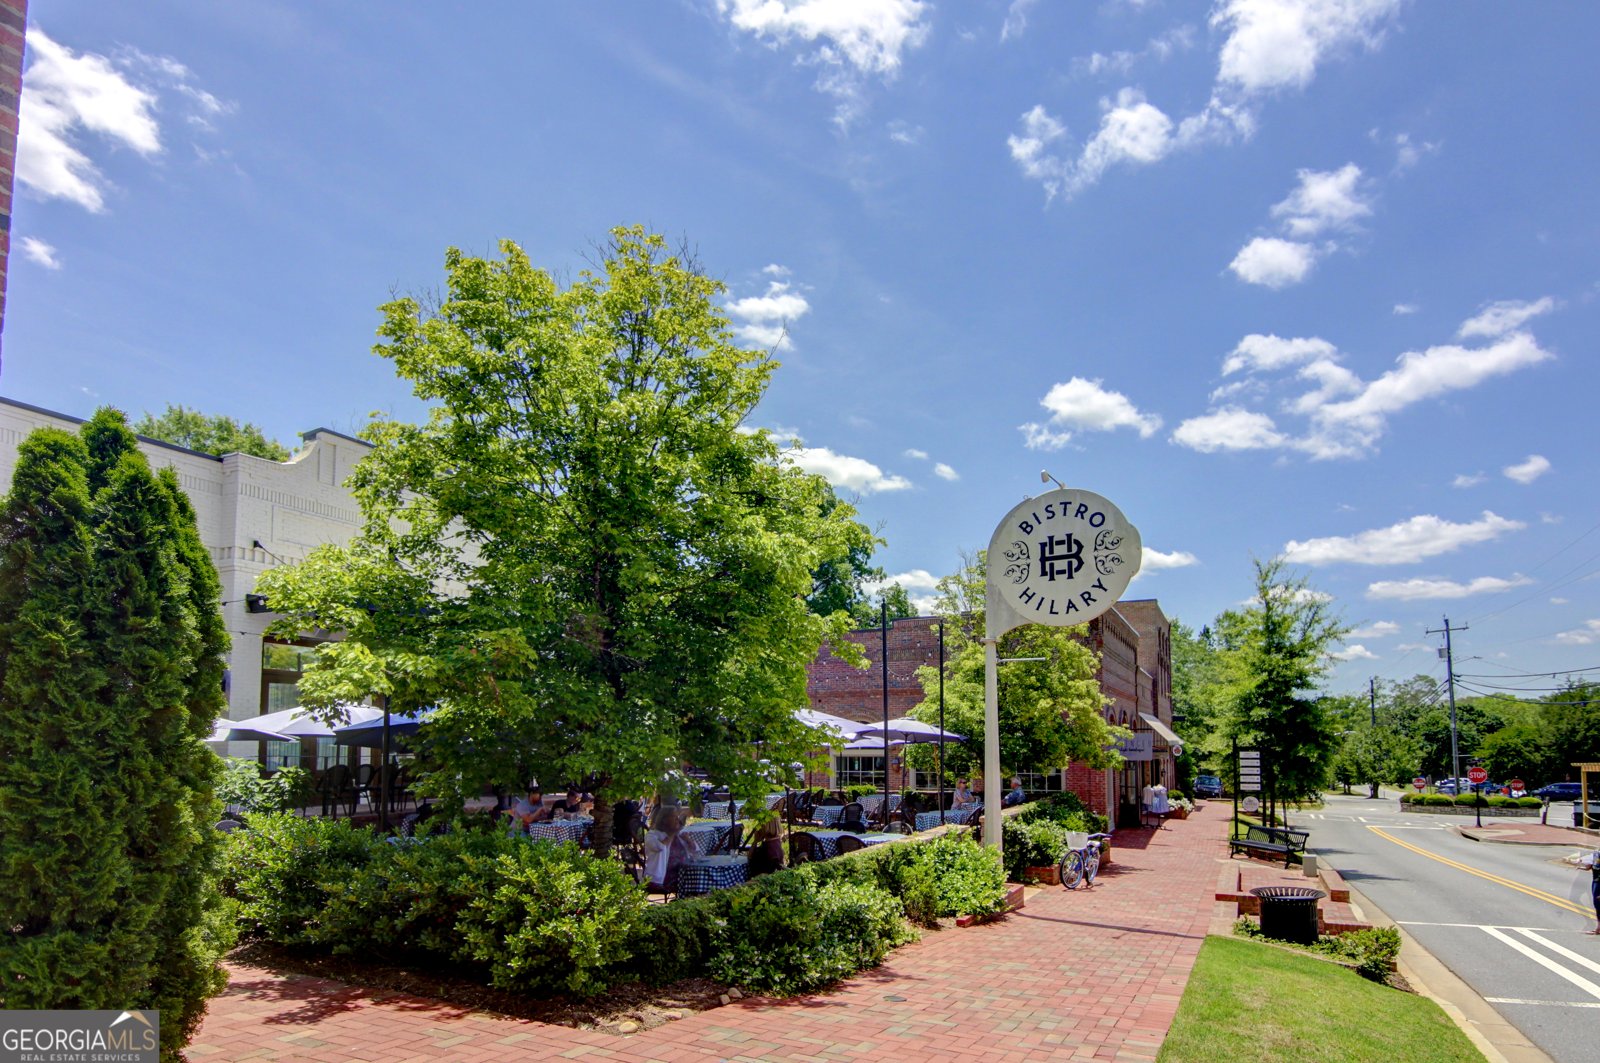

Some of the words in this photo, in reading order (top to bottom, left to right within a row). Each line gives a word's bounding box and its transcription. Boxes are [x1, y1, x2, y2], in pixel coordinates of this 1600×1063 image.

[1018, 501, 1106, 535] BISTRO
[1019, 578, 1108, 615] HILARY
[1469, 771, 1486, 779] STOP
